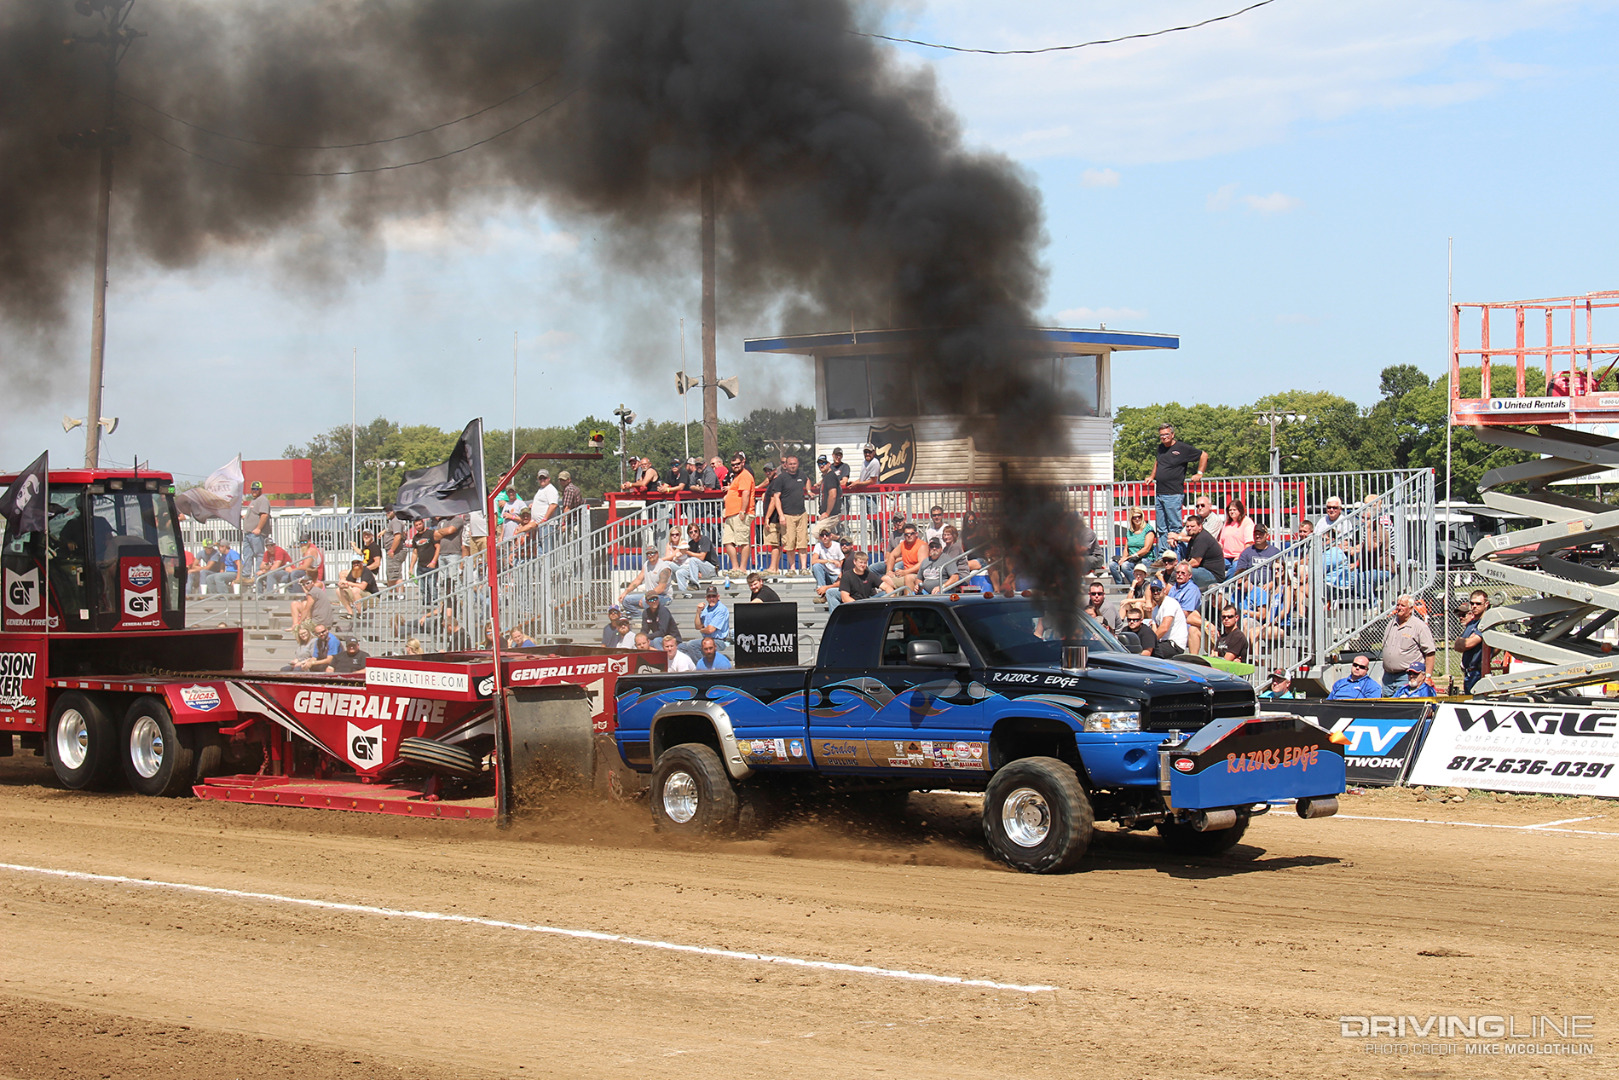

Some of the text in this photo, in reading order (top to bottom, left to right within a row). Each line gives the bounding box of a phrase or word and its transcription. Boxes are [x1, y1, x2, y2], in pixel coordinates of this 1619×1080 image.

[1504, 400, 1566, 409] United Rentals
[757, 634, 793, 646] RAM
[369, 671, 464, 688] GENERALTIRE.COM
[511, 663, 606, 681] GENERAL TIRE
[992, 672, 1079, 688] RAZORS EDGE
[188, 692, 215, 700] LUCAS
[293, 690, 447, 723] GENERAL TIRE
[1455, 734, 1551, 746] COMPETITION
[1227, 744, 1319, 773] RAZORS EDGE
[1447, 756, 1615, 778] 812-636-0391
